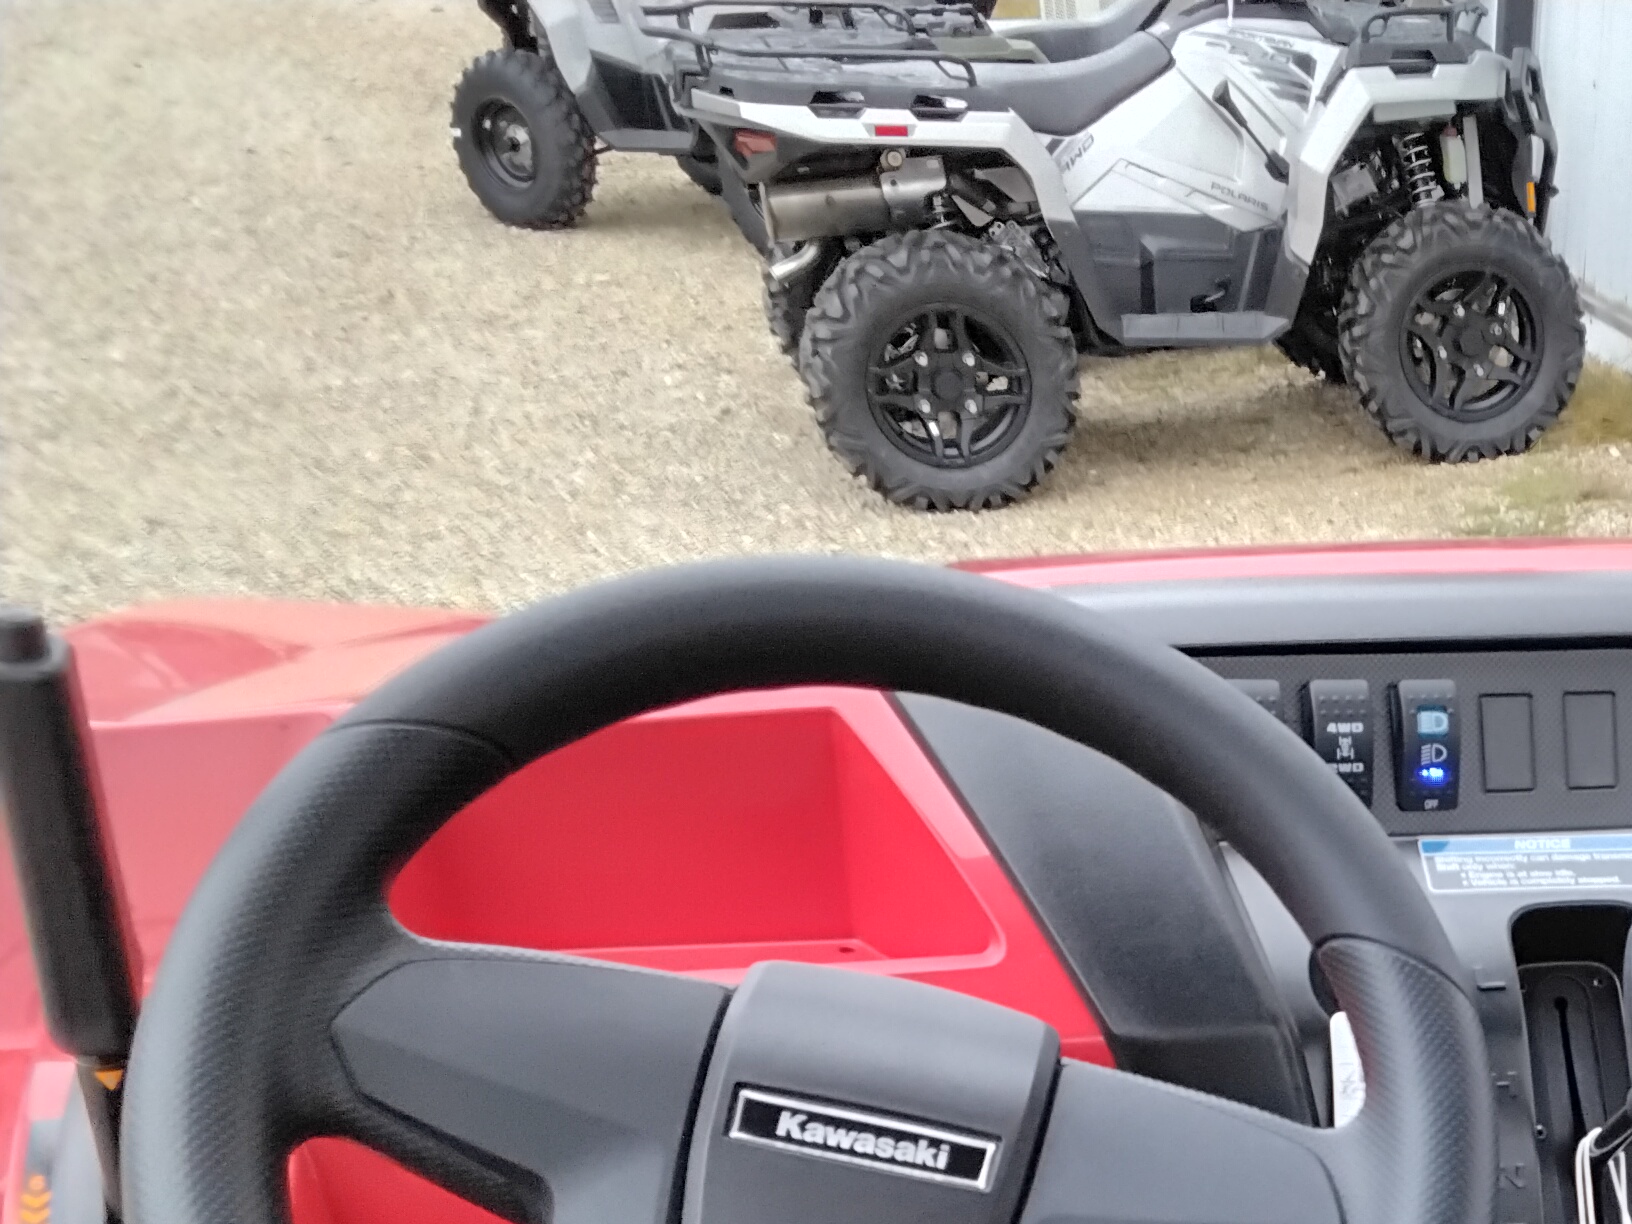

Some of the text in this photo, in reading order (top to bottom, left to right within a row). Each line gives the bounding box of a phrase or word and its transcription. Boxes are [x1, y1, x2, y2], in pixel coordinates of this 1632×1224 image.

[1210, 181, 1269, 211] POLARIS
[1326, 722, 1364, 733] 4WD
[1423, 799, 1439, 811] OFF
[1514, 838, 1571, 850] NOTICE
[775, 1110, 951, 1171] Kawasaki
